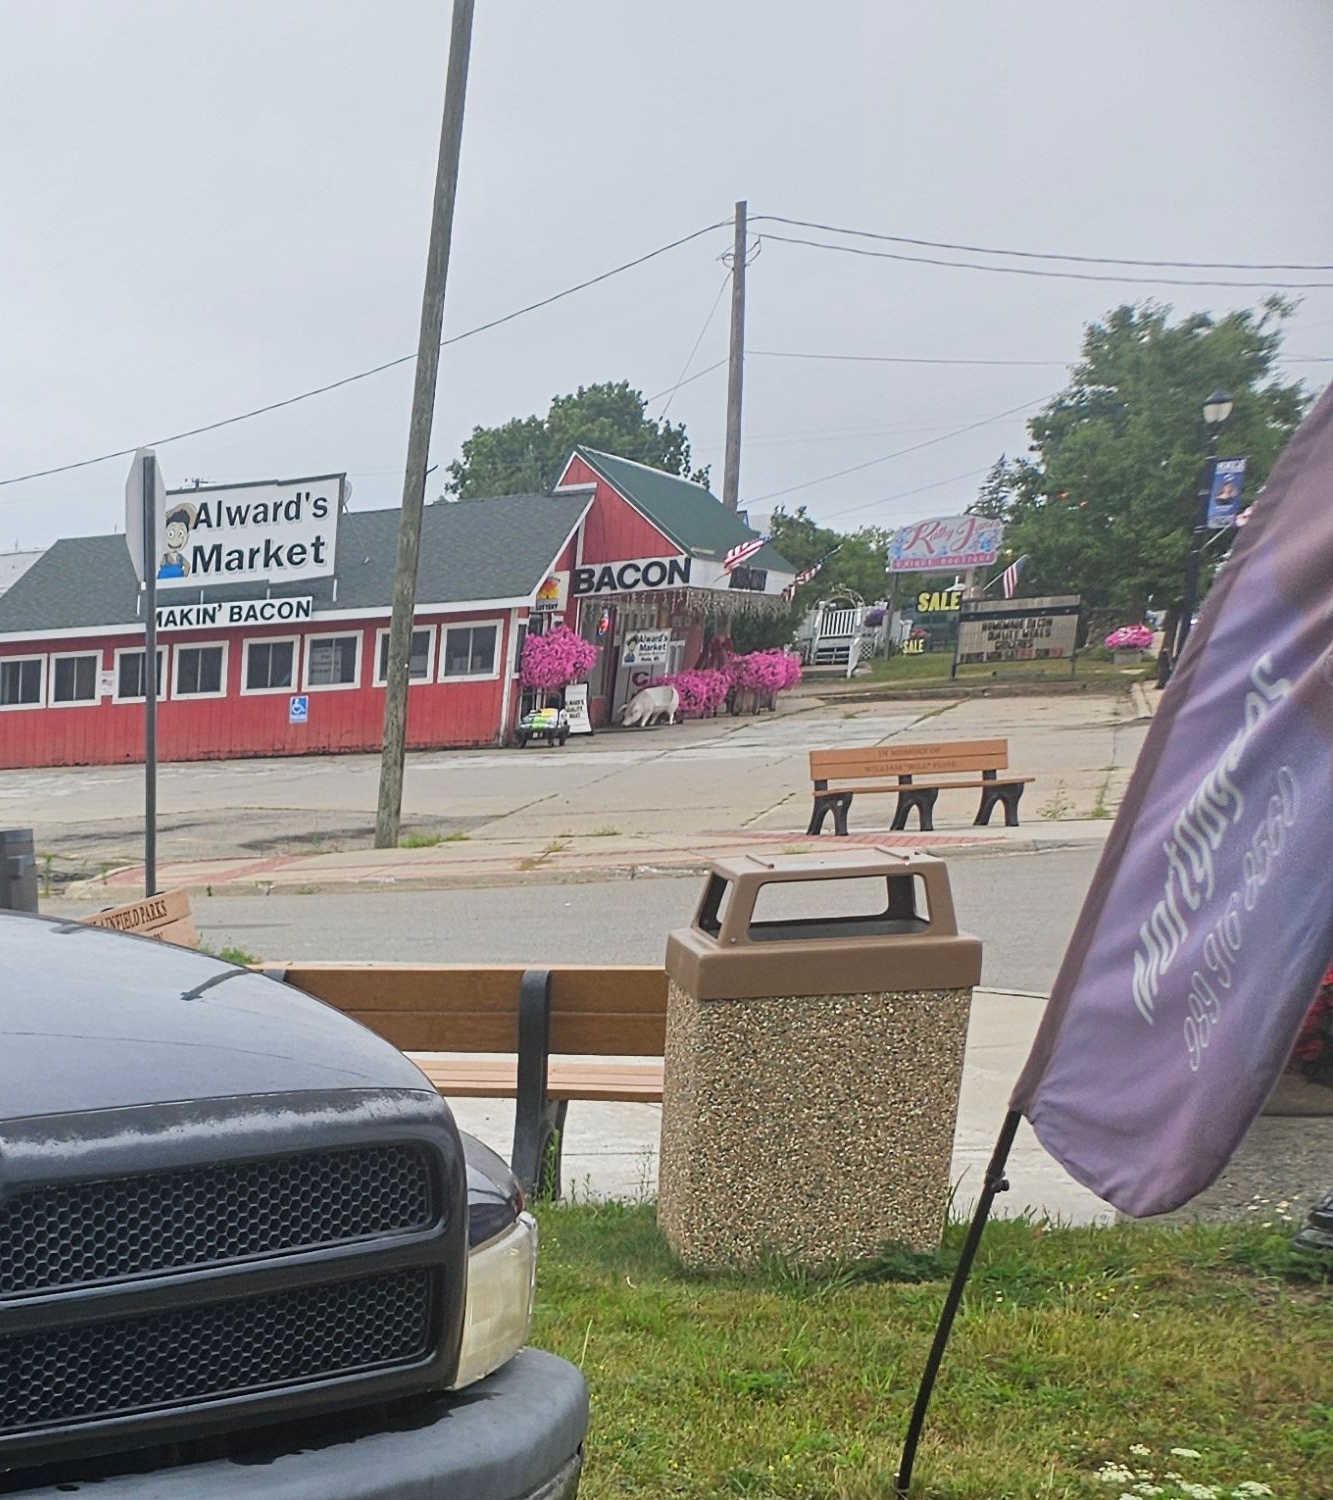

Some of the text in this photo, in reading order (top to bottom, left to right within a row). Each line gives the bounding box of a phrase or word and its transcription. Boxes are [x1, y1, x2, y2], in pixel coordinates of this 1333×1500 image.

[192, 492, 328, 530] Alward's
[191, 535, 326, 574] Market
[573, 557, 691, 593] BACON
[229, 600, 311, 622] BACON
[917, 591, 961, 612] SALE
[639, 643, 666, 651] Market
[903, 639, 925, 653] SALE
[1132, 650, 1293, 1026] Mortgages
[140, 900, 168, 923] PARKS
